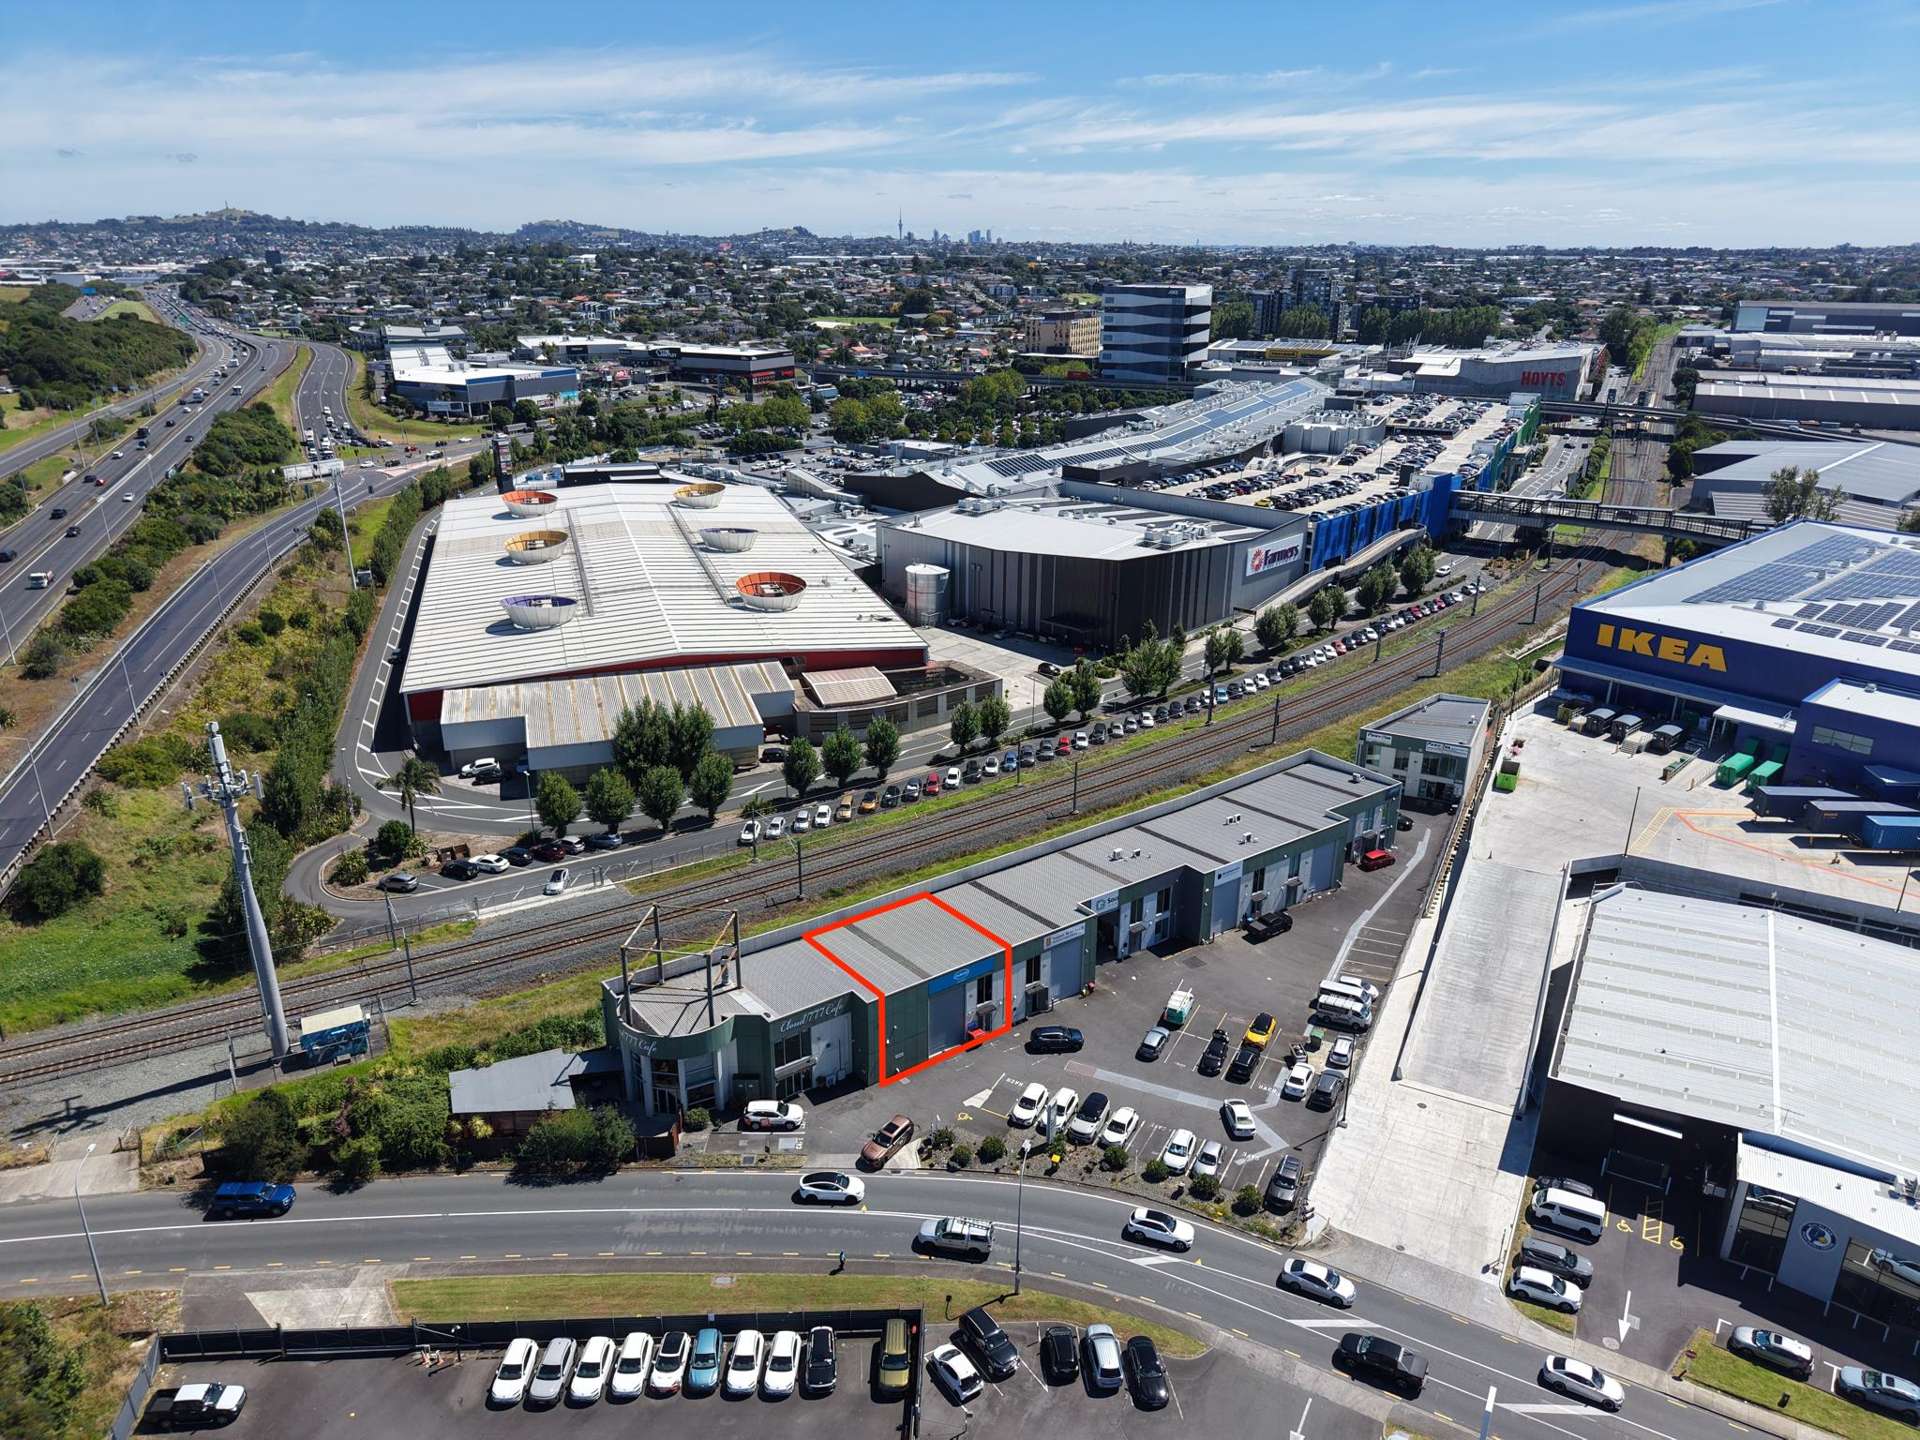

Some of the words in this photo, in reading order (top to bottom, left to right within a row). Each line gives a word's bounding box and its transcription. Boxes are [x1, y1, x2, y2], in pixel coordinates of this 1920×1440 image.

[1520, 370, 1567, 386] HOYTS
[1264, 544, 1299, 566] Farmers
[1596, 623, 1727, 672] IKEA
